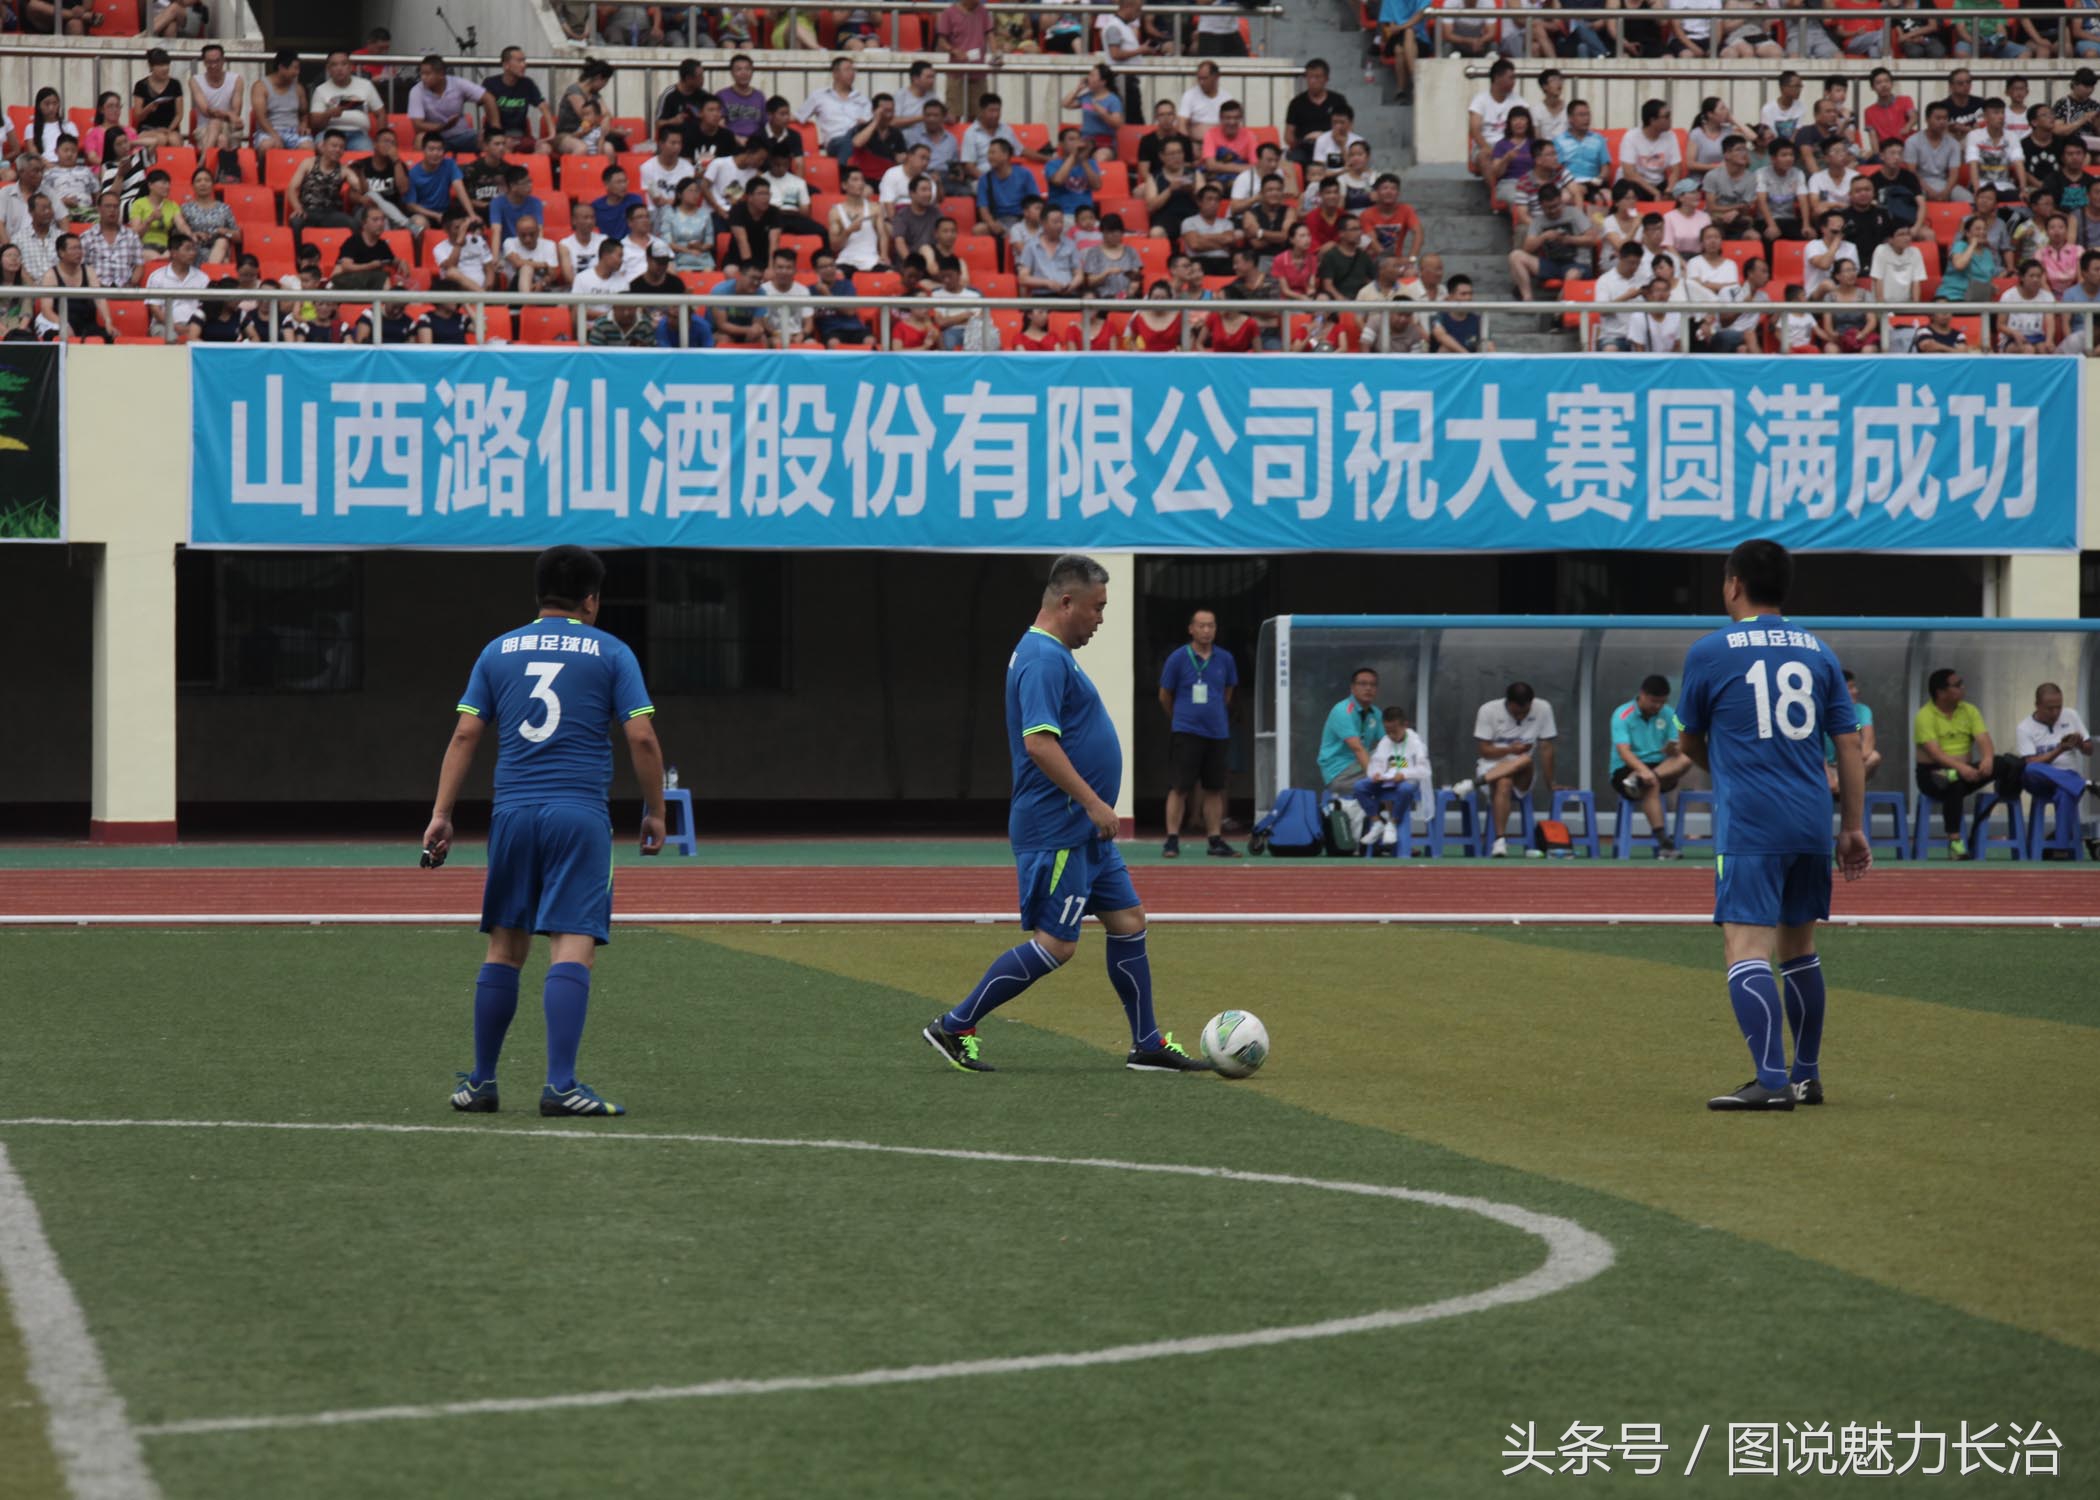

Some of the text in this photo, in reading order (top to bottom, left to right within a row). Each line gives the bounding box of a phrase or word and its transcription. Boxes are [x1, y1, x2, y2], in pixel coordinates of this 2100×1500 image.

[231, 373, 2039, 522] 山西潞仙酒股份有限公司祝大赛圆满成功
[501, 634, 600, 656] 明星足球队
[1726, 629, 1821, 652] 明星足球队
[518, 661, 565, 743] 3
[1745, 659, 1816, 741] 18
[1058, 894, 1087, 927] 17
